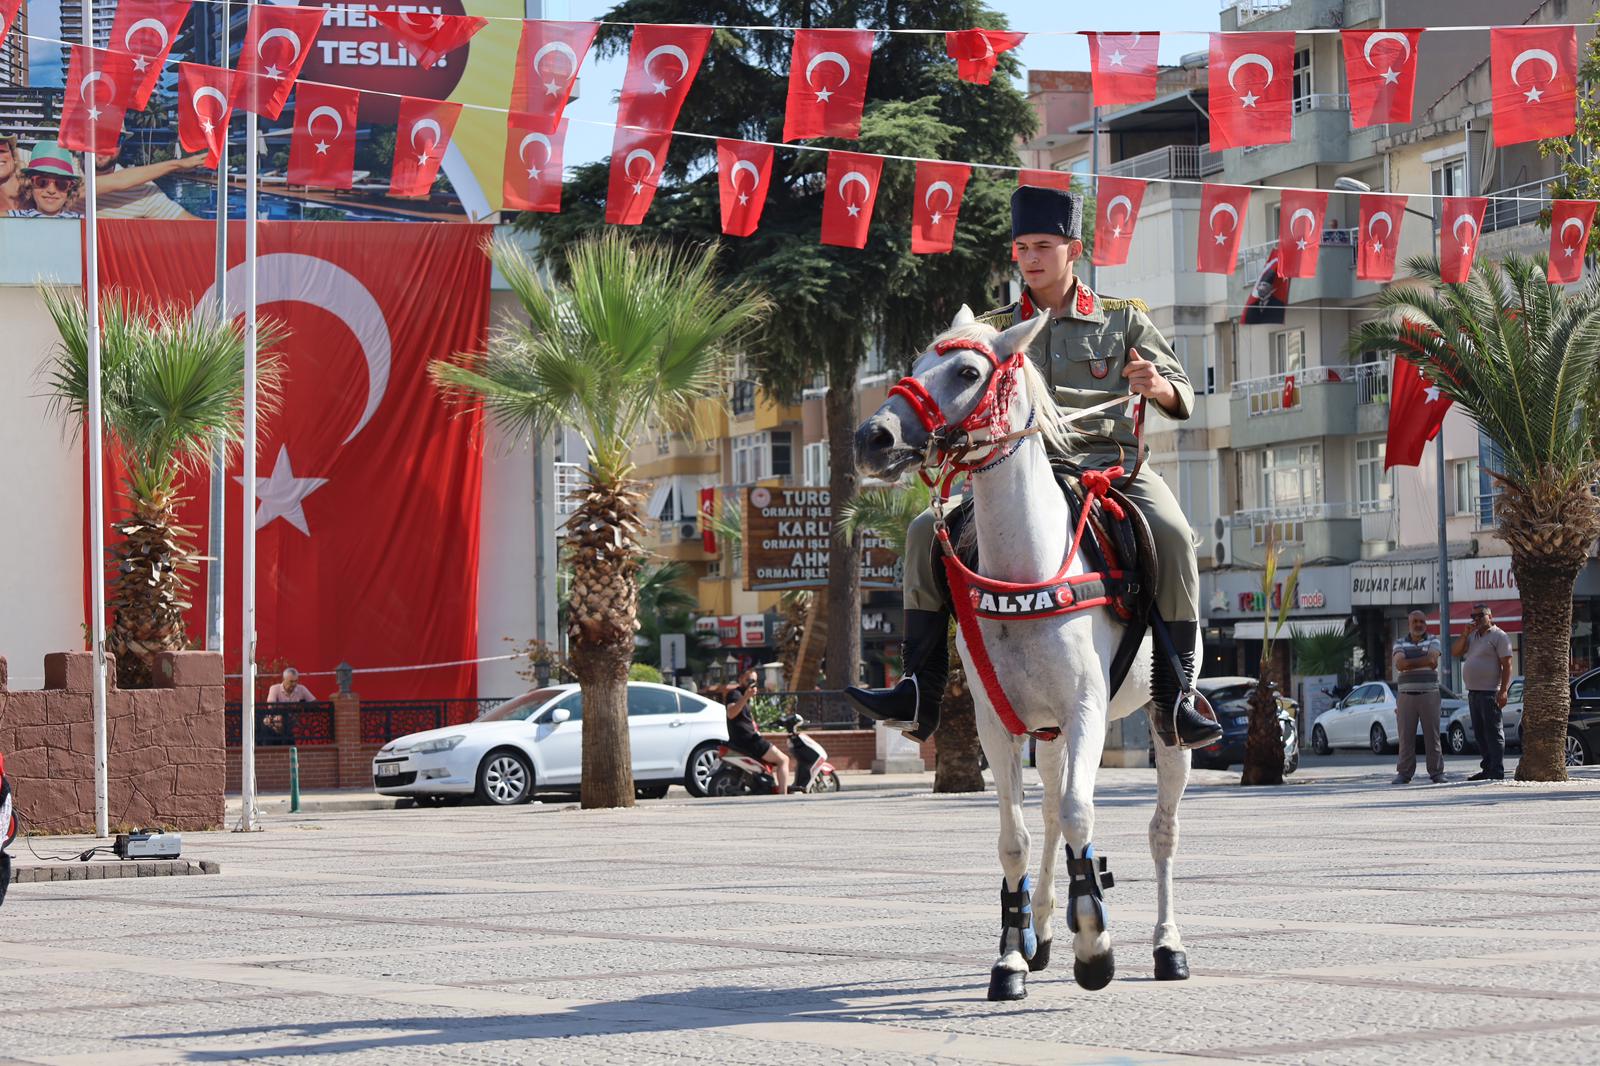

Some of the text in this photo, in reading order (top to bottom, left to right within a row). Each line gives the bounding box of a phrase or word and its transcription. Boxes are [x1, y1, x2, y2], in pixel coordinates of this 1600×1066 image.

[783, 491, 832, 506] TURG
[762, 507, 804, 518] ORMAN
[778, 521, 832, 537] KARL
[762, 539, 804, 550] ORMAN
[757, 569, 800, 579] ORMAN
[1474, 563, 1505, 590] HİLAL
[1352, 577, 1389, 593] BULVAR
[1391, 576, 1428, 593] EMLAK
[979, 591, 1055, 613] ALYA
[1300, 590, 1323, 607] mode
